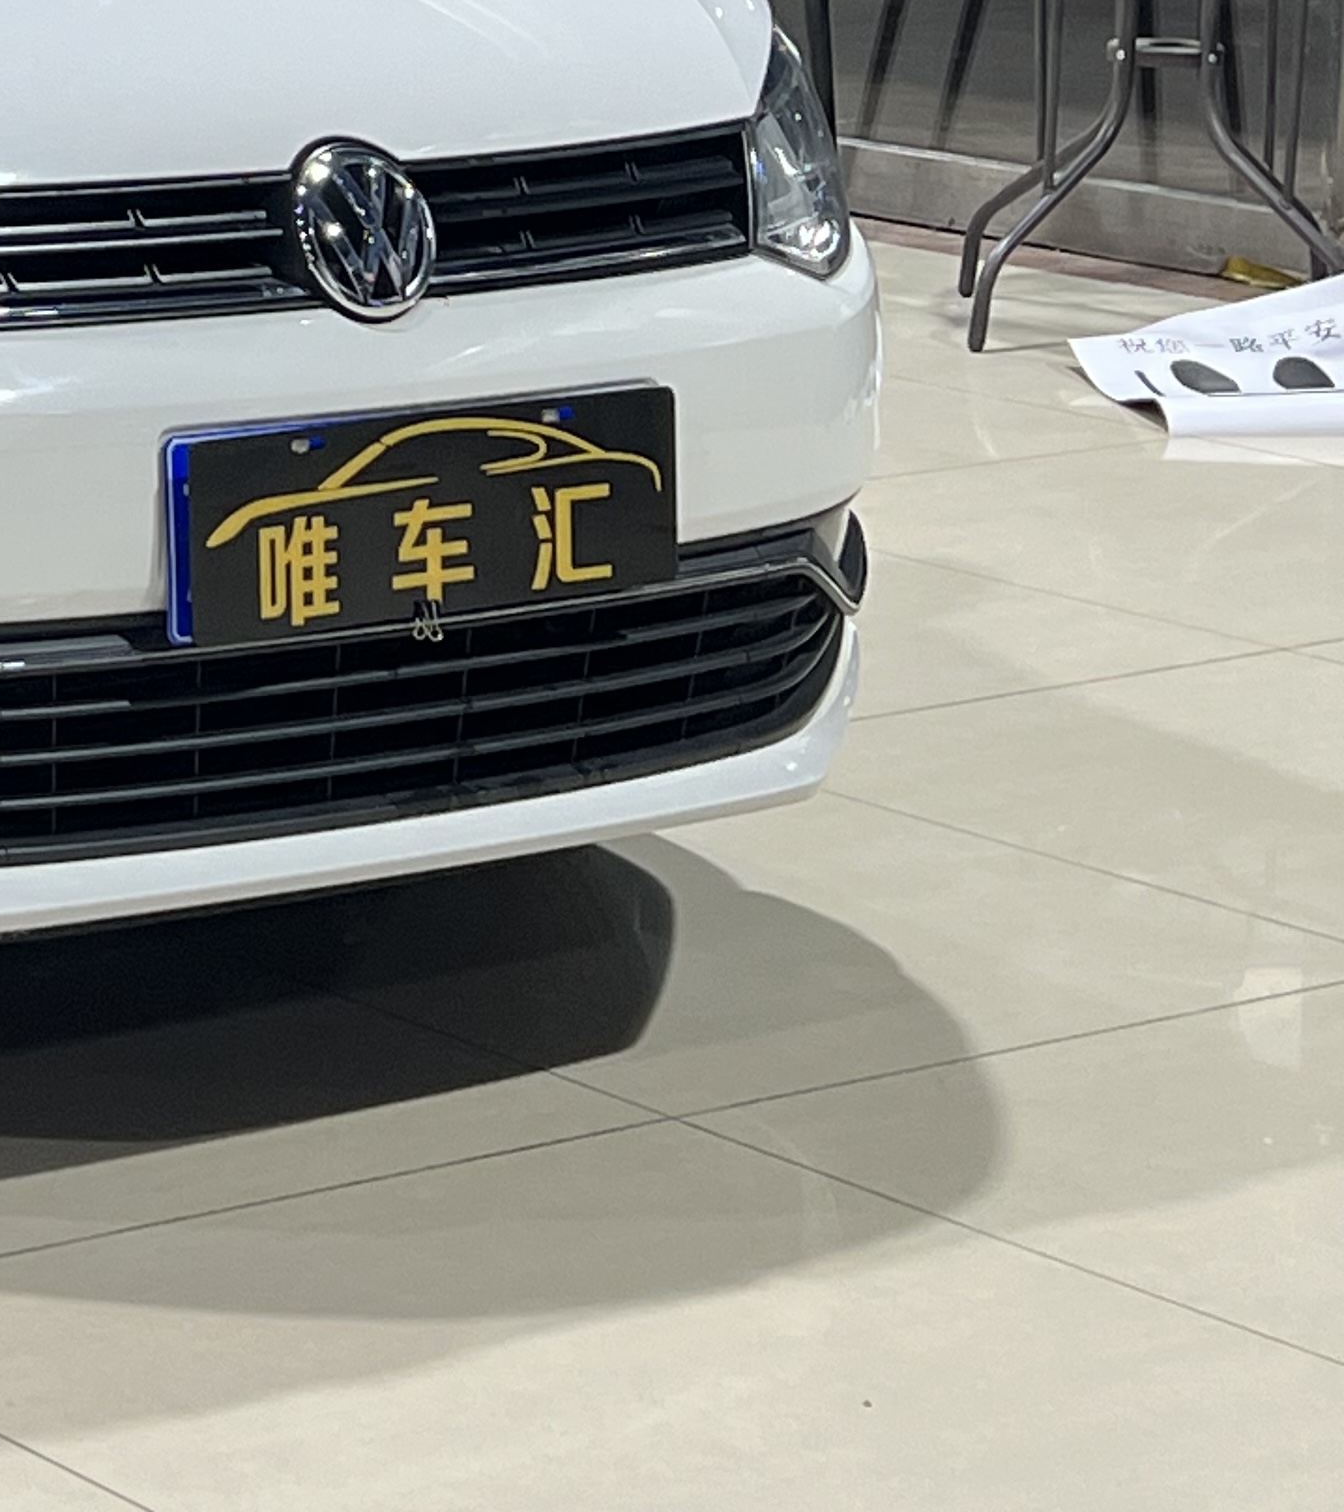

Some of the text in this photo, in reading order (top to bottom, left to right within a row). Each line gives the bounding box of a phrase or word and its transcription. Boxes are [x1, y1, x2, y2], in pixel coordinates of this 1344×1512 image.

[1118, 317, 1343, 355] 祝您一路平安
[257, 482, 613, 627] 唯车汇
